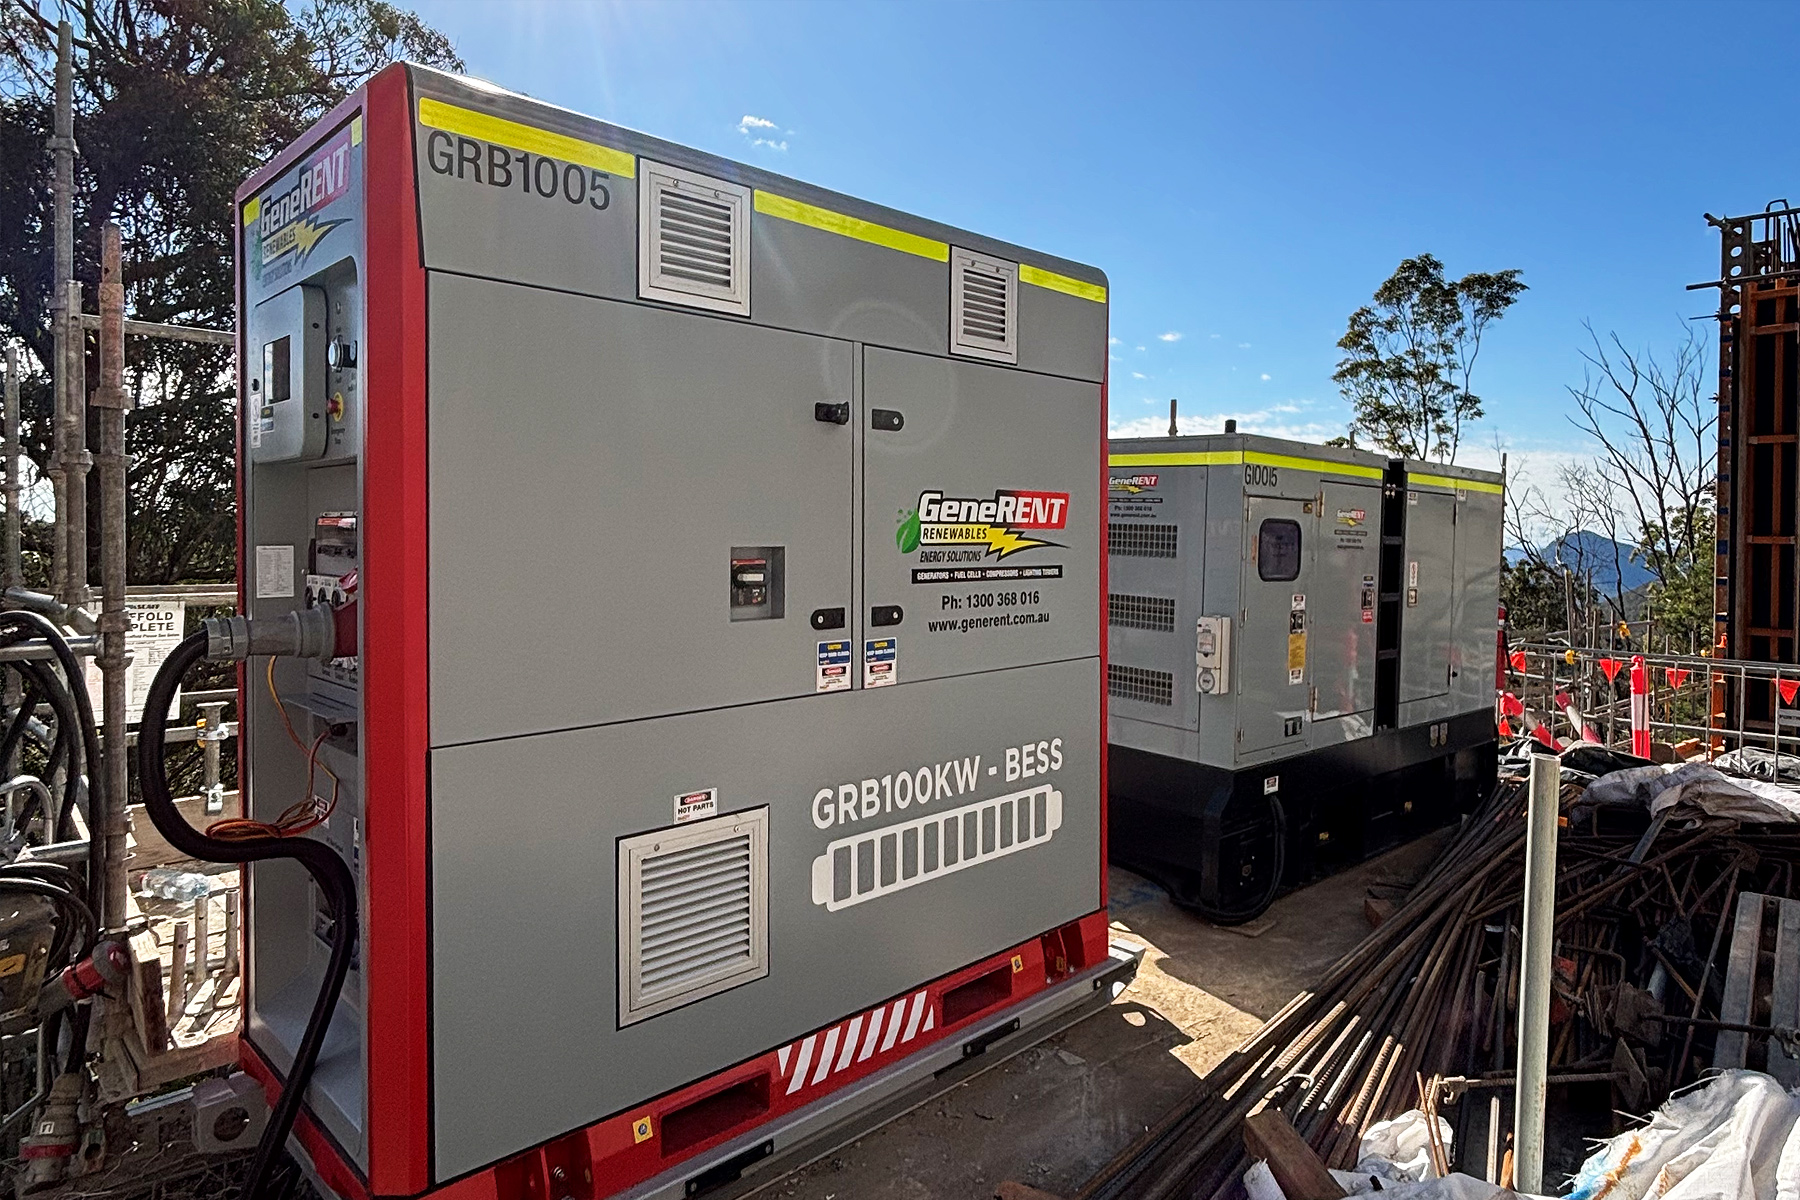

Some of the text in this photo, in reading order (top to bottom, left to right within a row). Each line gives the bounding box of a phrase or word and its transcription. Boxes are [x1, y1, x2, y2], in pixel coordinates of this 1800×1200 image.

[427, 130, 611, 211] GRB1005
[261, 142, 349, 236] GeneRENT
[1109, 475, 1158, 485] GeneRENT
[1244, 465, 1278, 487] G10015
[918, 491, 1066, 525] GeneRENT
[922, 527, 987, 540] RENEWABLES
[920, 550, 982, 562] ENERGY SOLUTIONS
[917, 571, 949, 580] GENERATORS
[954, 571, 966, 579] FUEL
[967, 570, 981, 578] CELLS
[941, 591, 1040, 610] Ph: 1300 368 016
[129, 611, 174, 621] FFOLD
[928, 612, 1050, 633] www.generent.com.au
[131, 622, 174, 631] PLETE
[811, 755, 980, 829] GRB100KW
[1005, 738, 1063, 782] BESS
[678, 802, 714, 814] HOT PARTS
